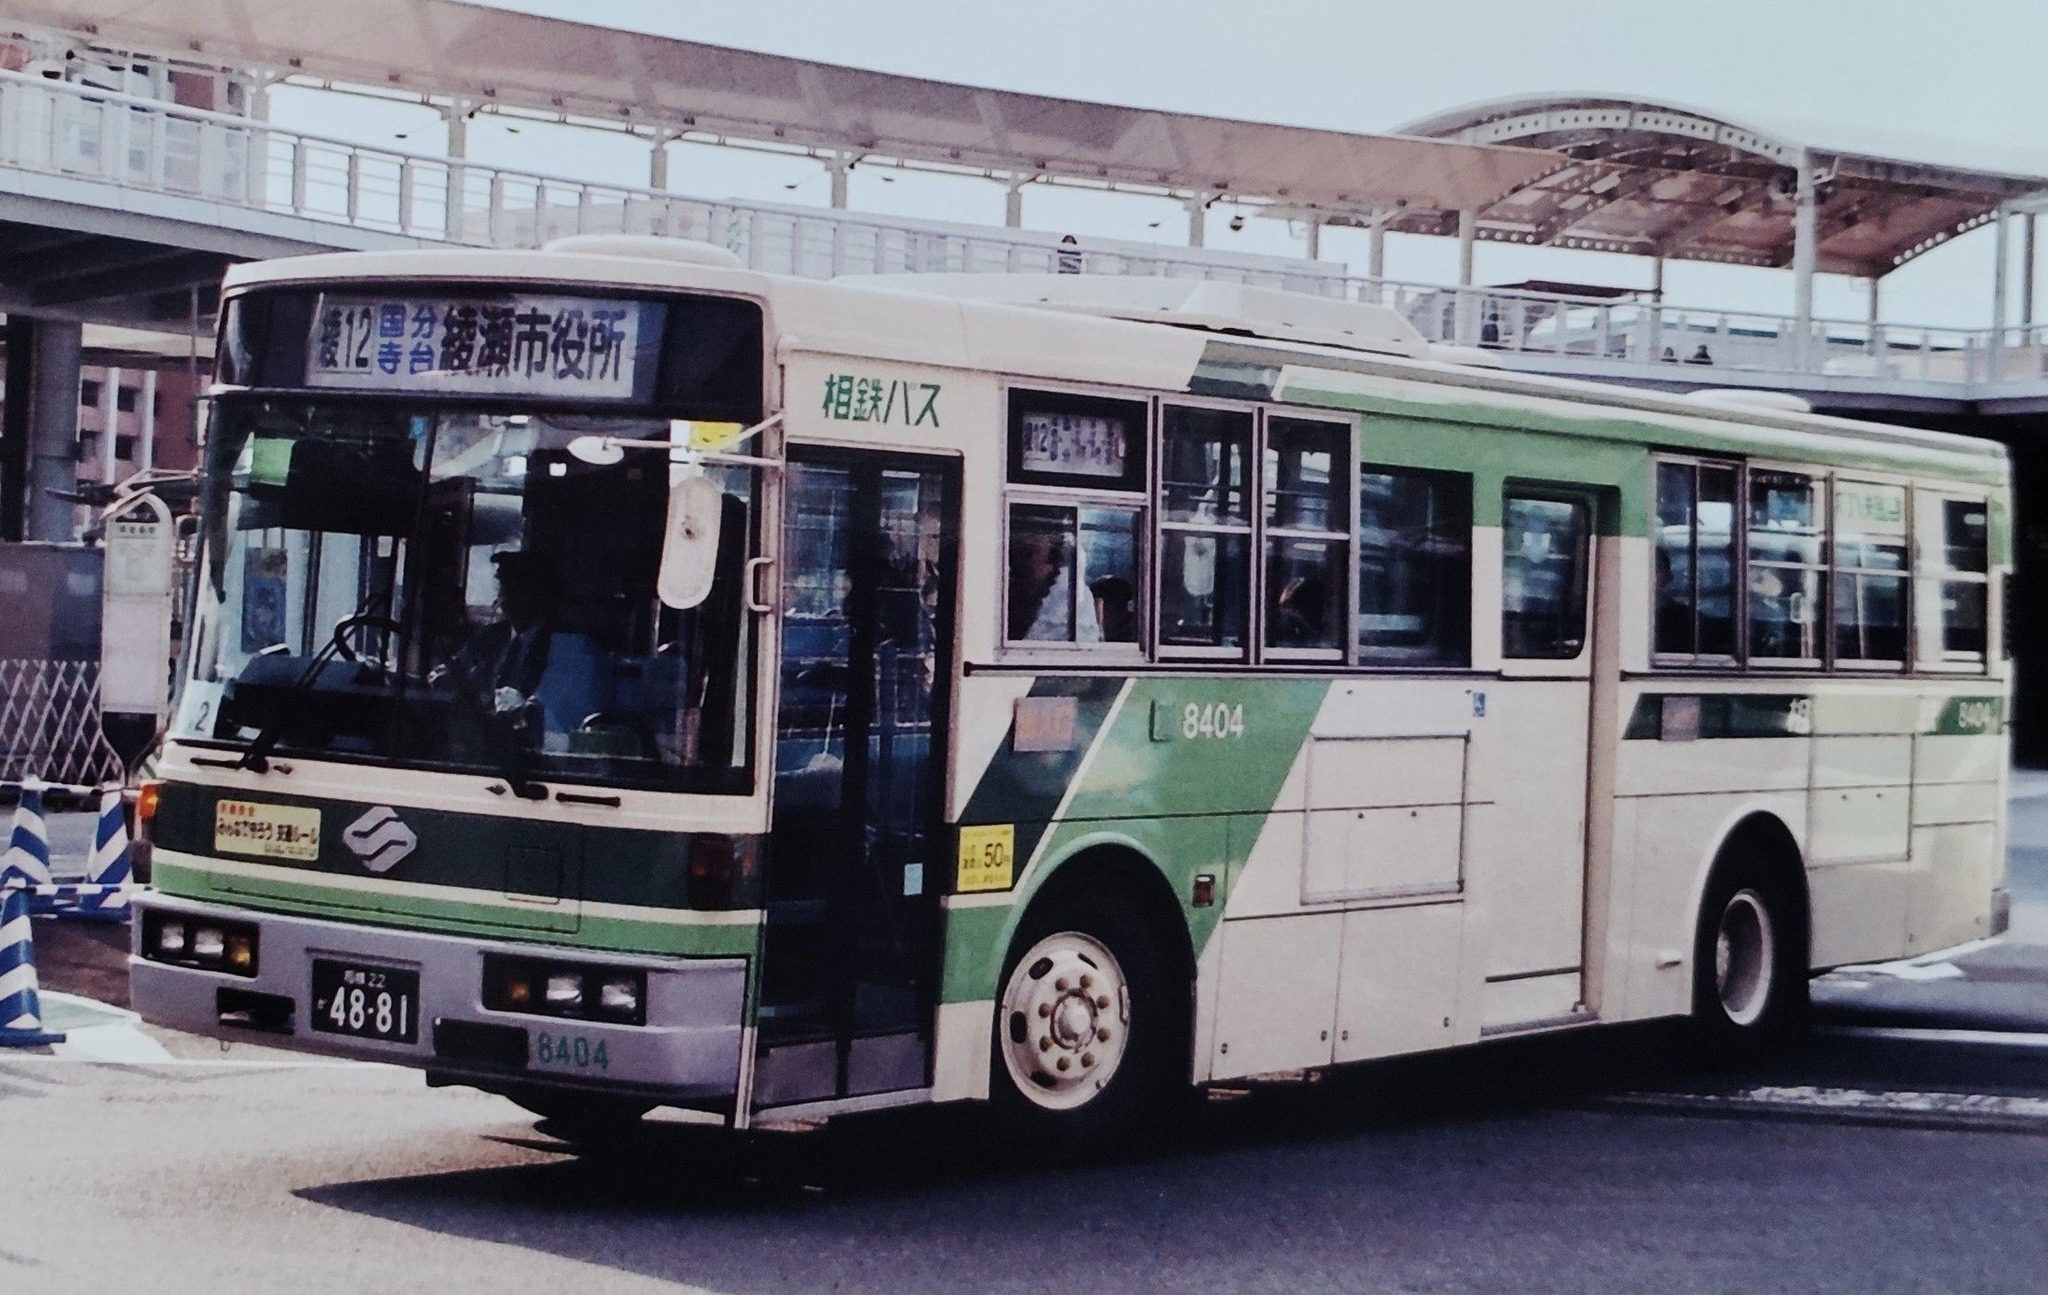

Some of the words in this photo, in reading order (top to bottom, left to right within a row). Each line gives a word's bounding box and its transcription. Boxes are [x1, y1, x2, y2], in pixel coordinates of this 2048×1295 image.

[438, 306, 627, 383] 綾瀬市役所
[822, 373, 942, 428] 相鉄バス
[1182, 702, 1244, 740] 8404
[984, 842, 1003, 868] 50
[368, 973, 386, 988] 22
[537, 1031, 610, 1069] 8404
